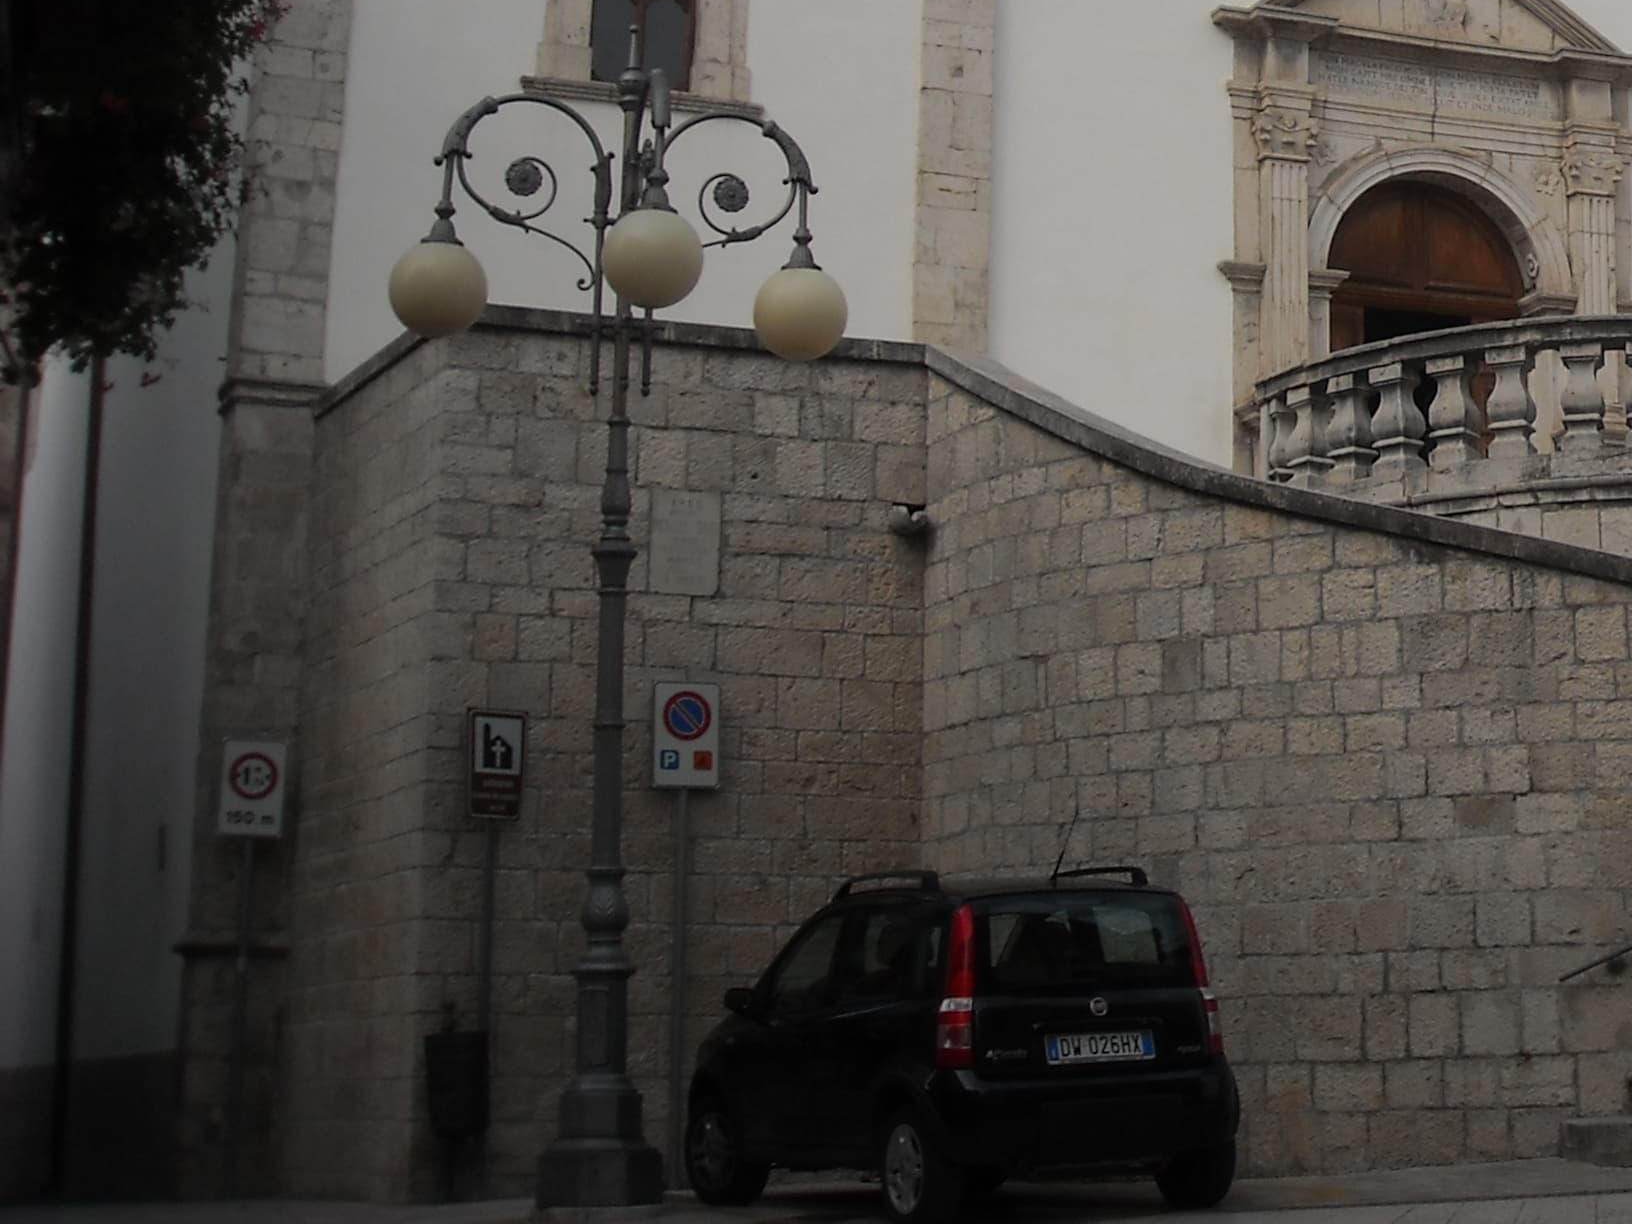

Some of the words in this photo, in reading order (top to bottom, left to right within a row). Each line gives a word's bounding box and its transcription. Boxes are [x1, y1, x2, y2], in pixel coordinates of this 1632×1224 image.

[663, 751, 677, 769] P
[1060, 1036, 1082, 1057] DW
[1088, 1033, 1142, 1055] 026HX
